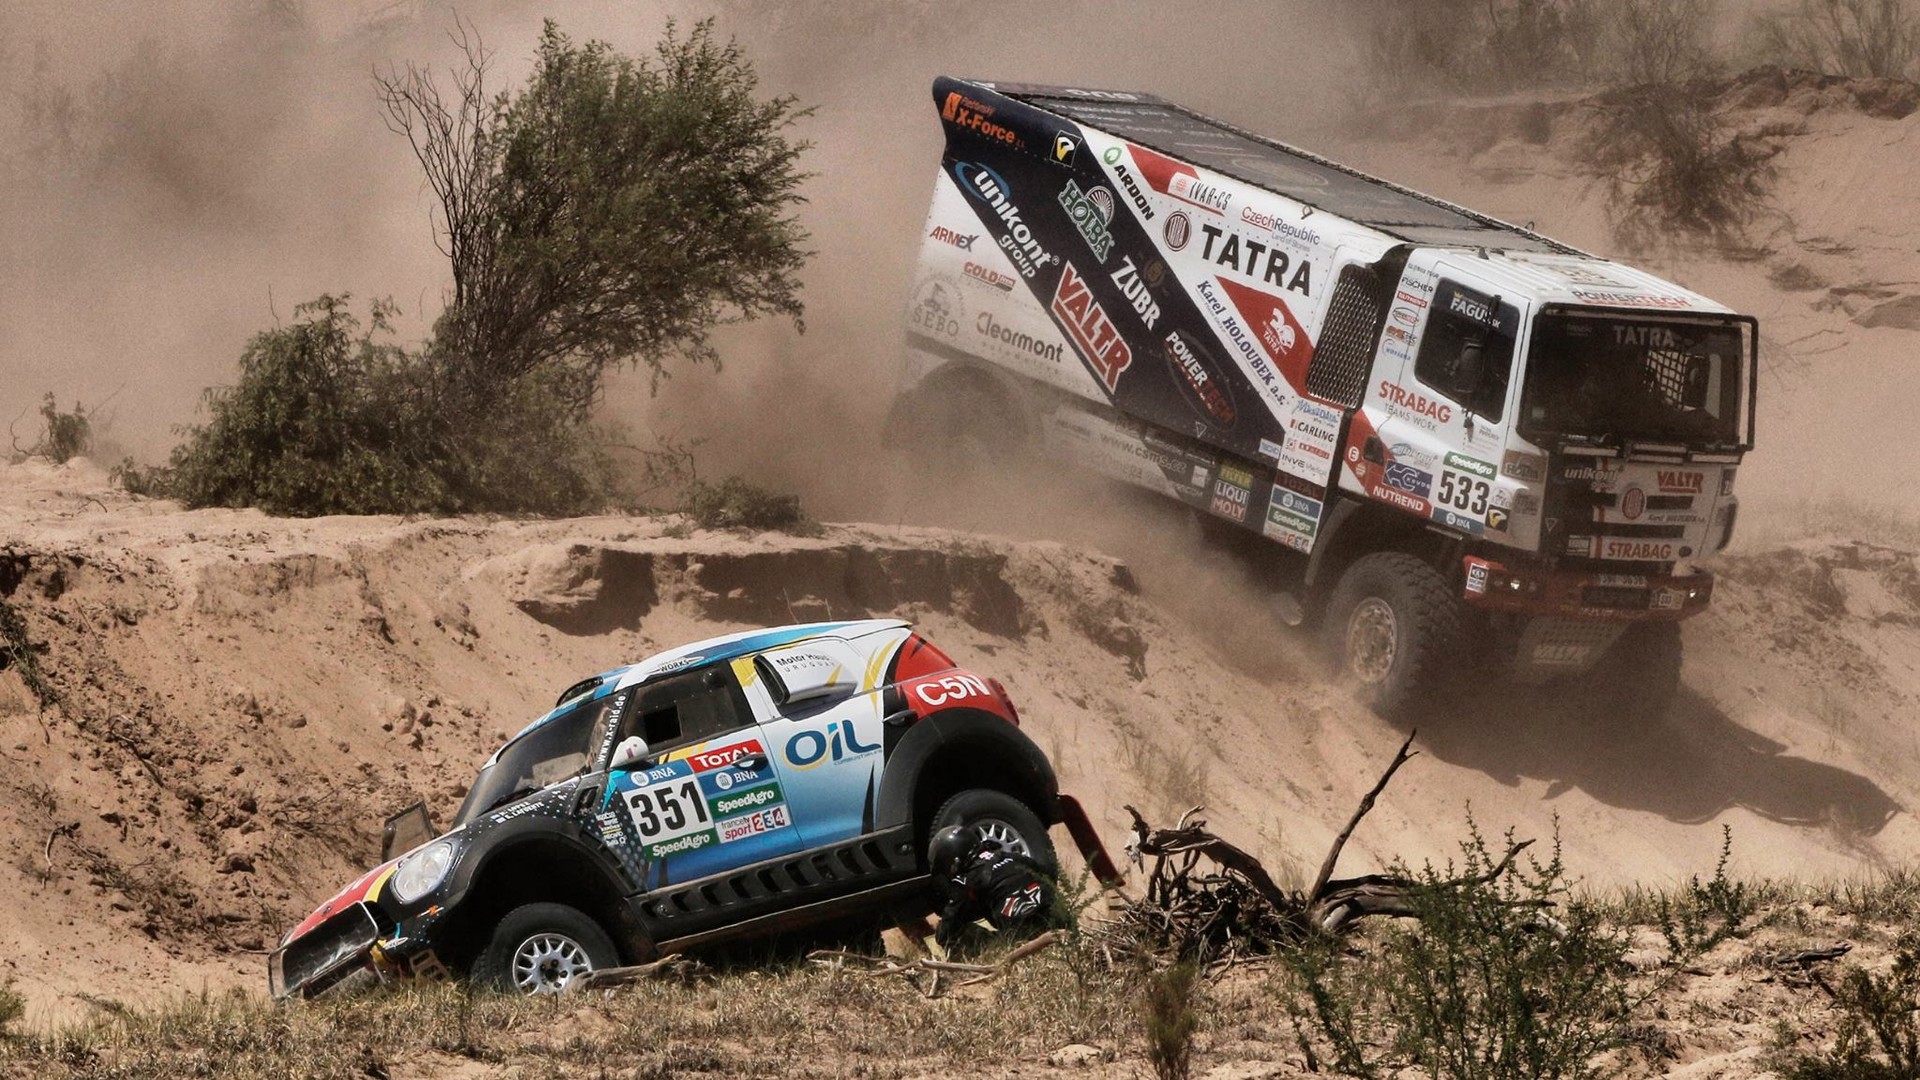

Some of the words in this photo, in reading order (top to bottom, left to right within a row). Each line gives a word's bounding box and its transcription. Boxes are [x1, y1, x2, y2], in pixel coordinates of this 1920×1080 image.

[956, 107, 1015, 144] X-Force
[1114, 164, 1154, 221] ARDON
[1058, 178, 1115, 264] HOLBA
[1241, 205, 1321, 246] CzechRepublic
[1000, 234, 1036, 279] group
[1202, 224, 1311, 297] TATRA
[963, 261, 1000, 285] GOLD
[1110, 255, 1161, 330] ZUBR
[977, 311, 1064, 363] Clearmont
[1051, 260, 1132, 395] VALTR
[1613, 325, 1675, 347] TATRA
[1197, 280, 1226, 315] Karel
[1222, 316, 1275, 386] HOLOUBEK
[1269, 385, 1286, 406] a.s.
[1379, 381, 1451, 423] STRABAG
[1297, 422, 1335, 443] CARLING
[1450, 455, 1493, 475] SpeedAgro
[1217, 481, 1248, 504] LIQUI
[1438, 470, 1490, 515] 533
[1657, 471, 1704, 493] VALTR
[1212, 497, 1246, 519] MOLY
[1373, 486, 1424, 511] NUTREND
[1608, 542, 1672, 560] STRABAG
[661, 660, 690, 672] WORKS
[776, 654, 805, 666] Motor
[915, 673, 991, 706] C5N
[694, 745, 757, 769] TOTAL
[651, 767, 676, 781] BNA
[734, 770, 758, 784] BNA
[630, 781, 708, 837] 351
[717, 788, 775, 813] SpeedAgro
[721, 815, 752, 830] francetv
[752, 813, 764, 832] 2
[763, 810, 775, 828] 3
[773, 807, 786, 826] 4
[725, 823, 752, 840] sport
[653, 832, 710, 858] SpeedAgro
